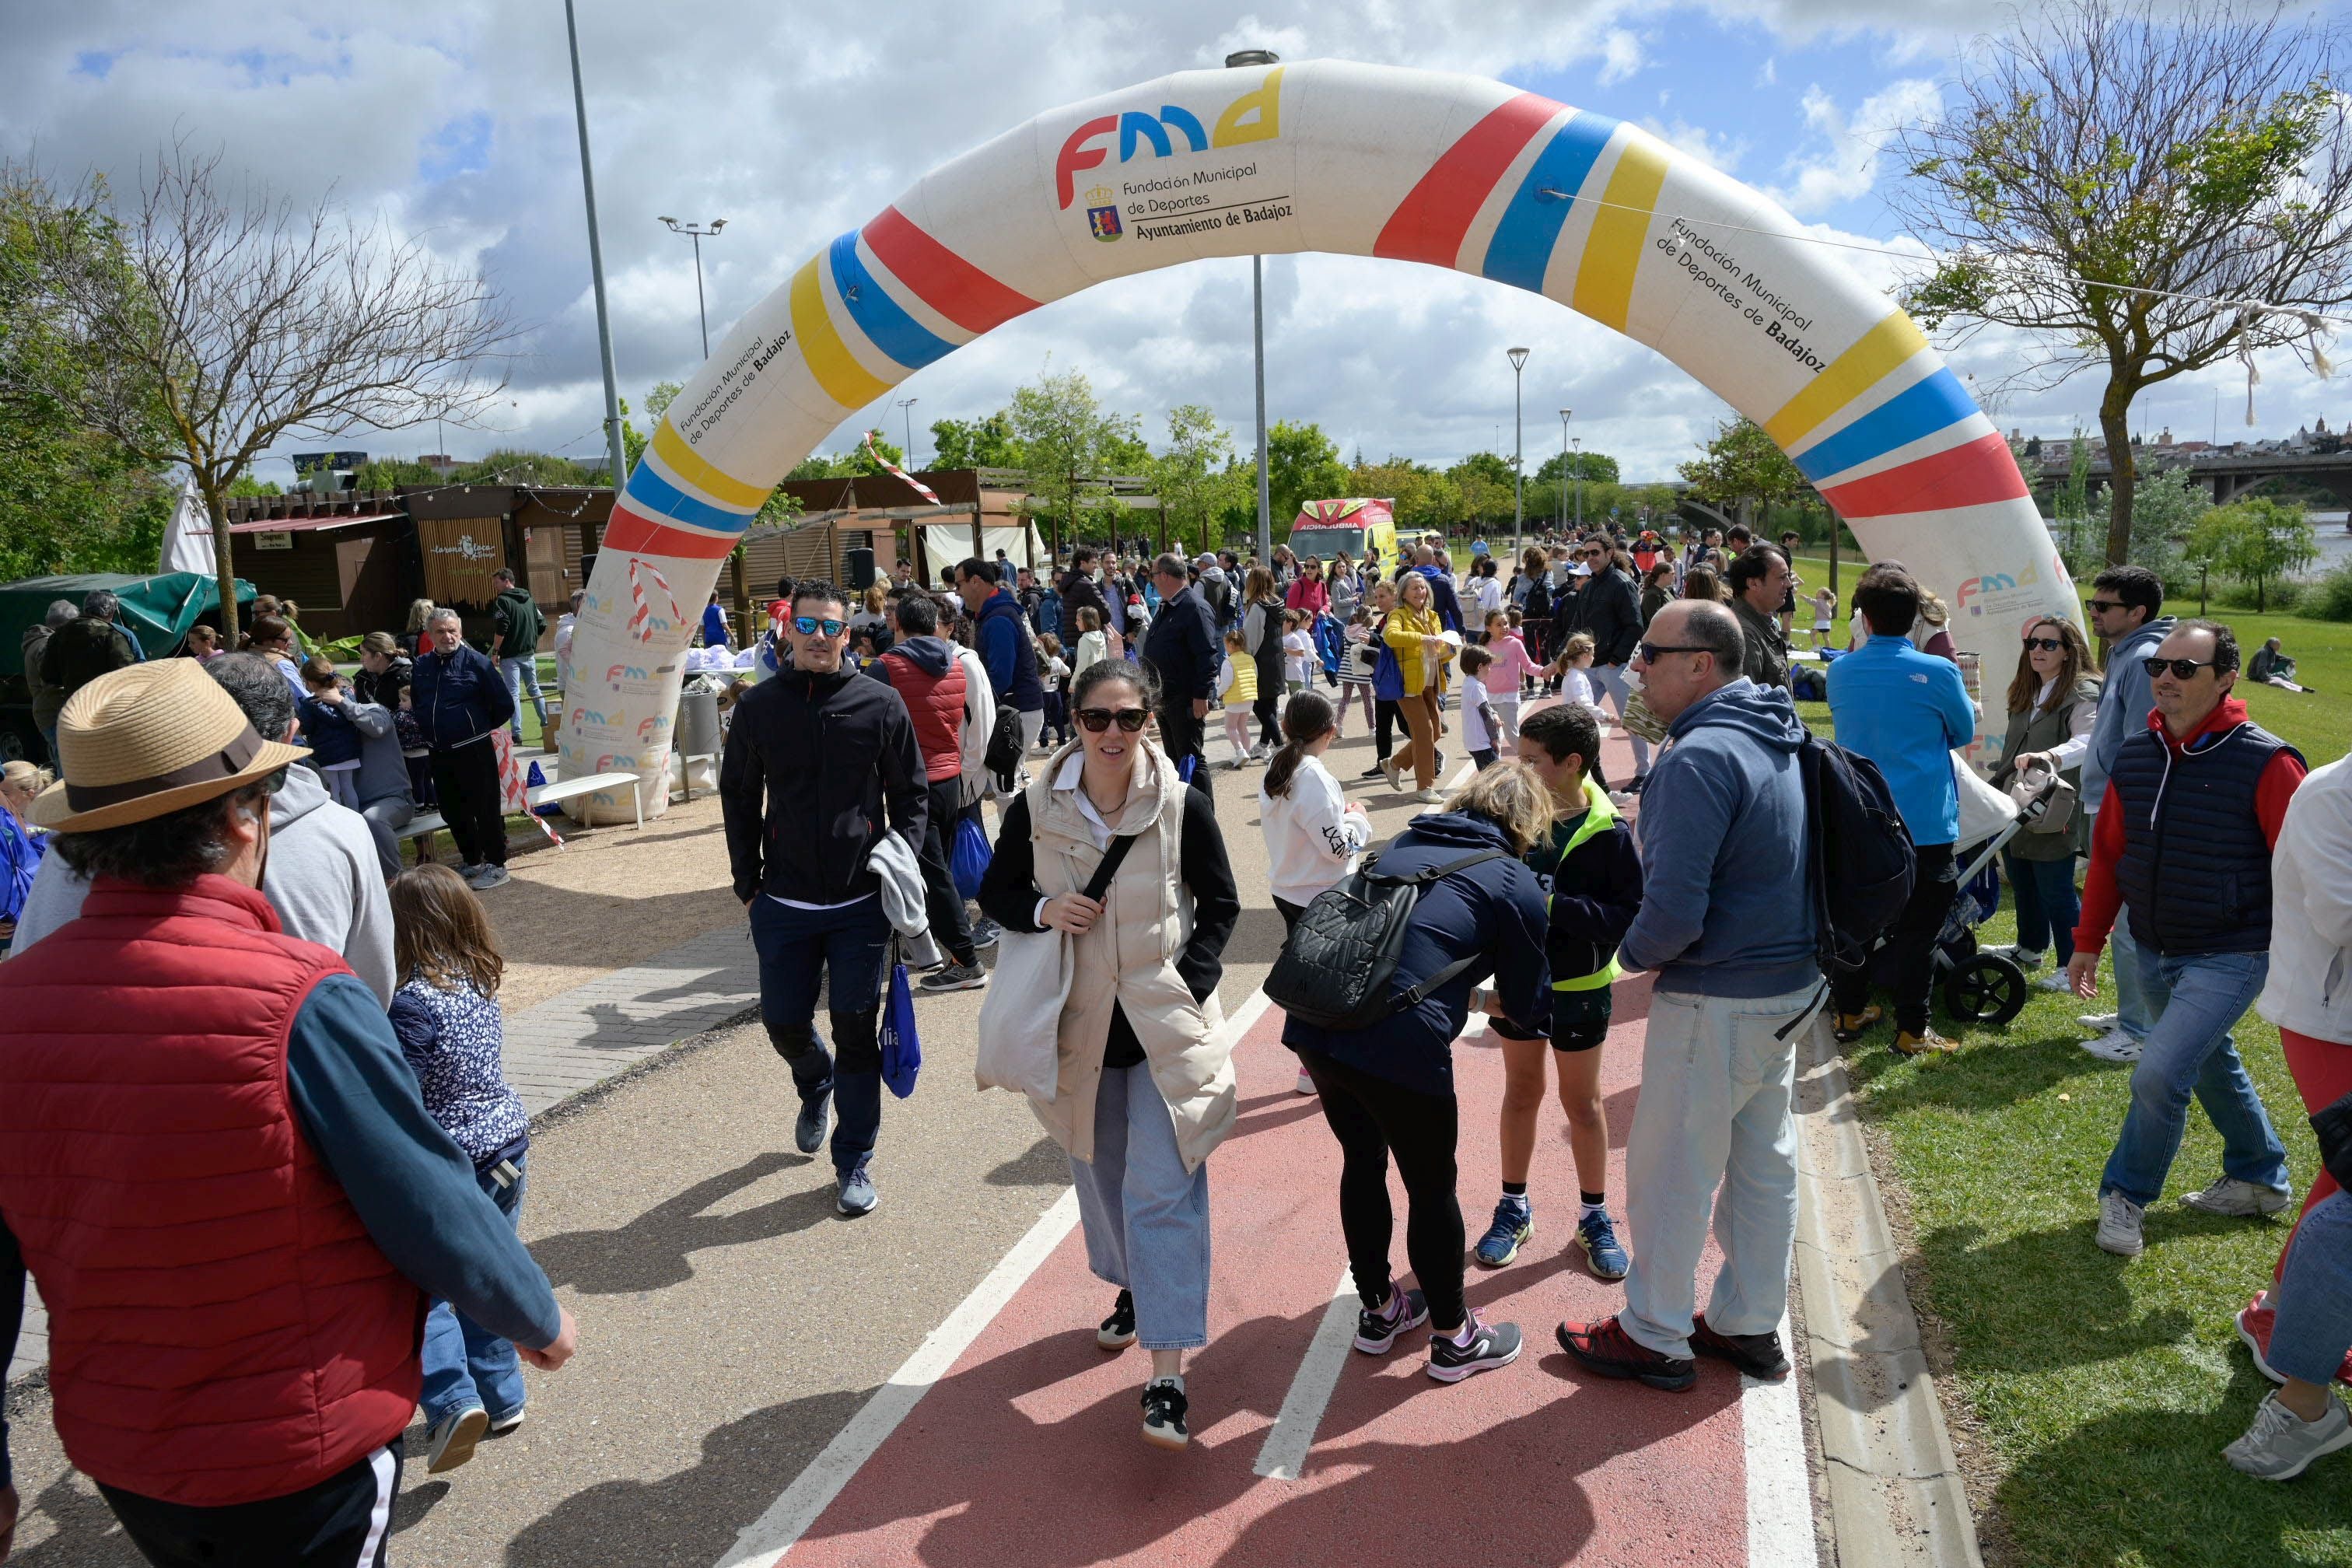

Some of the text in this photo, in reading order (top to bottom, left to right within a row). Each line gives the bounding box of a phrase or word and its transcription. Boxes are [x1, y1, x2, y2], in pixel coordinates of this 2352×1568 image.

[1123, 162, 1257, 195] Fundación Municipal
[1128, 193, 1210, 215] de Deportes
[1136, 203, 1293, 241] Ayuntamiento de Badajoz
[1657, 238, 1826, 373] de Deportes de Badajoz
[1671, 217, 1813, 331] Fundación Municipal
[680, 336, 764, 432] Fundación Municipal
[690, 330, 791, 445] de Deportes de Badajoz
